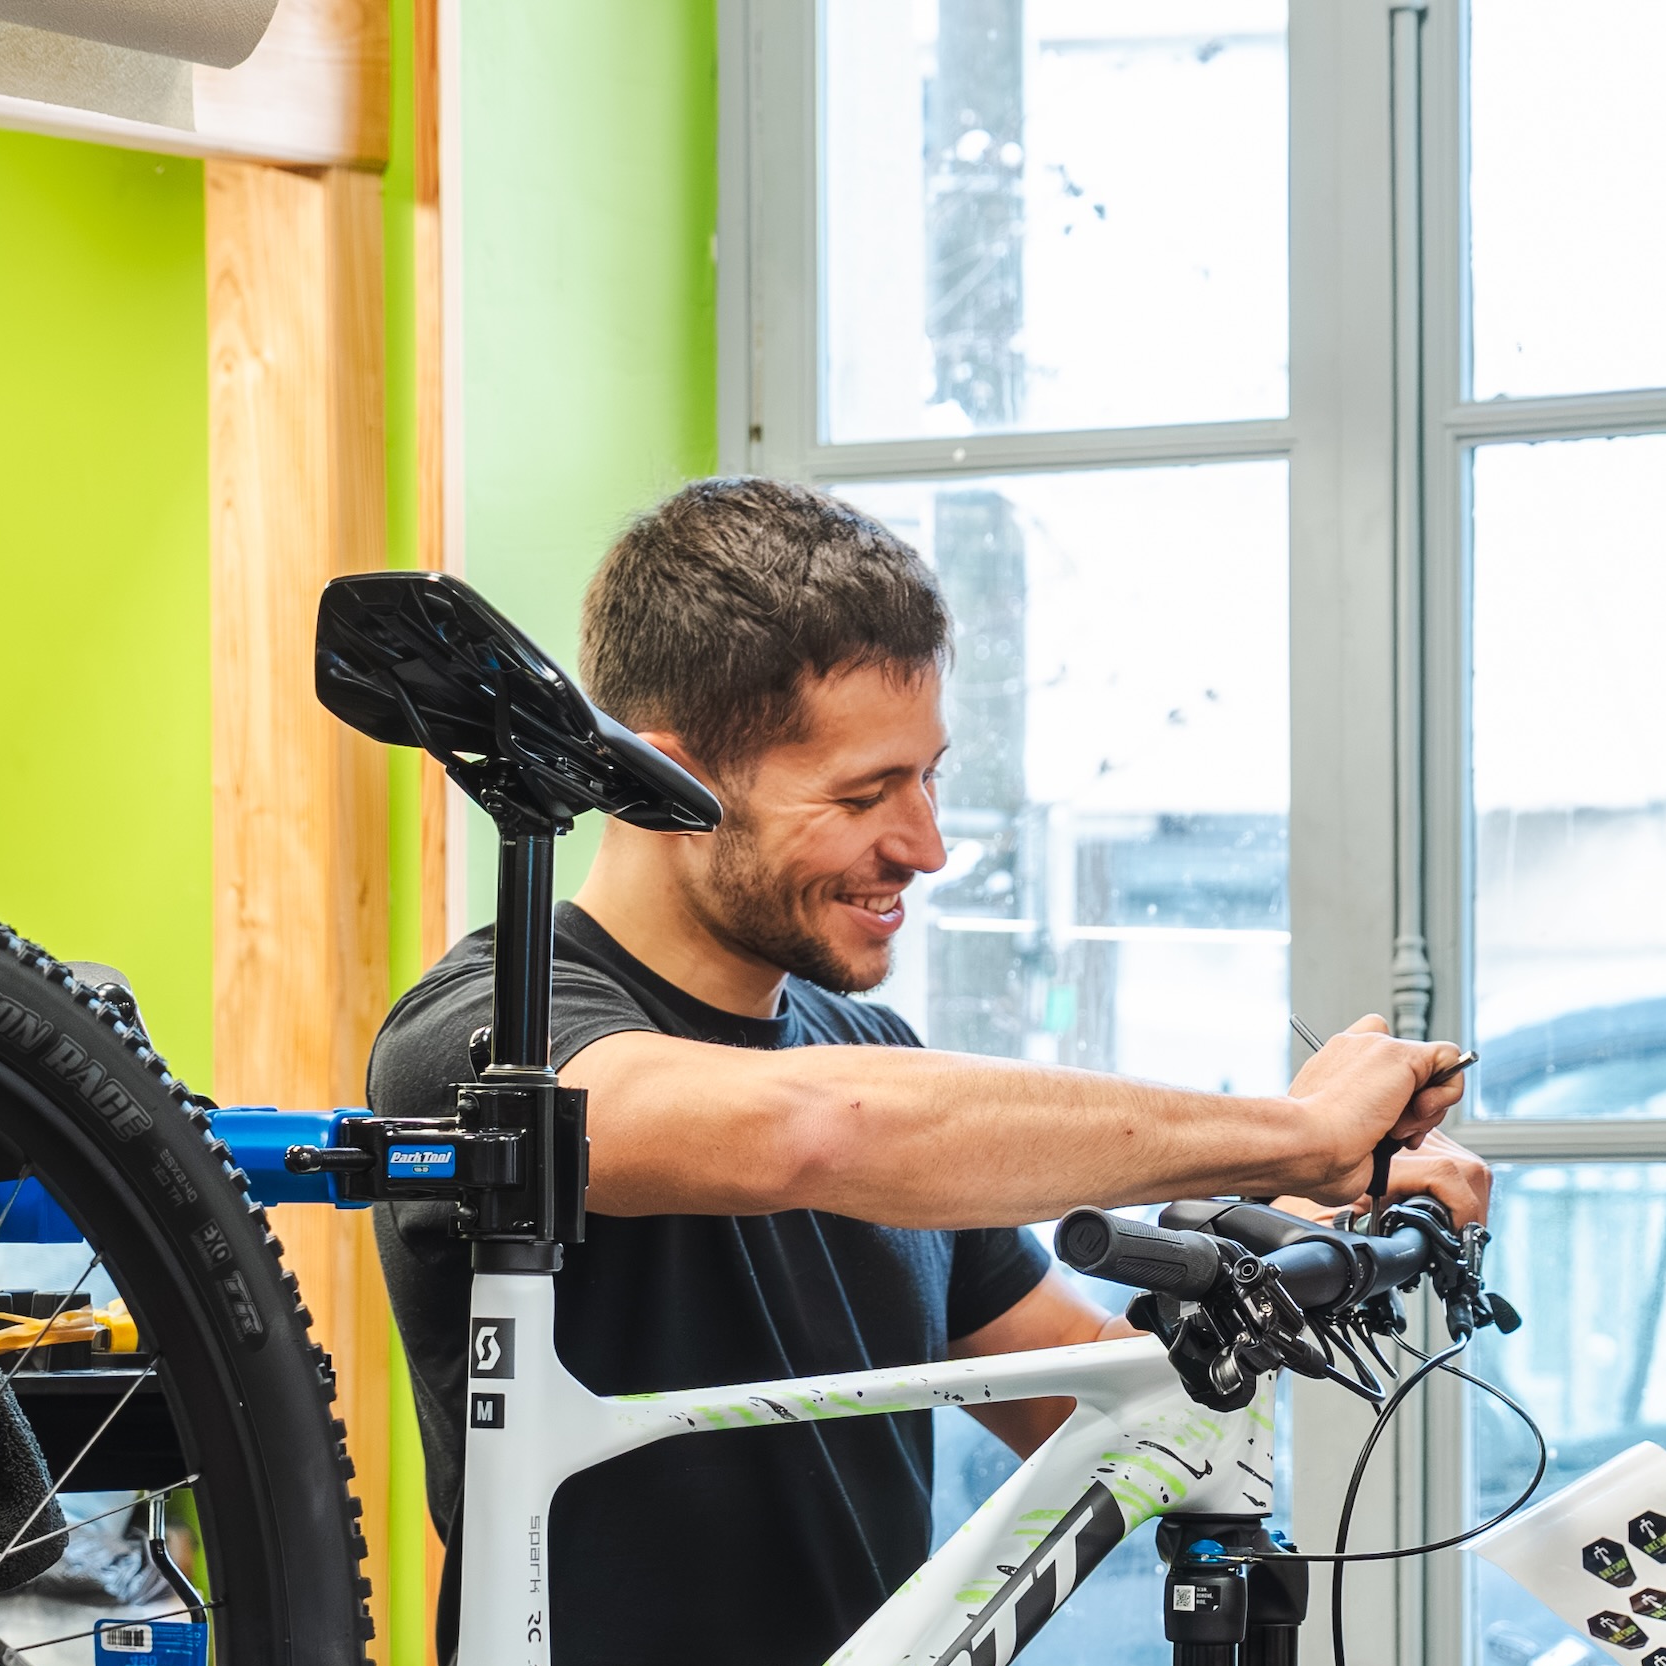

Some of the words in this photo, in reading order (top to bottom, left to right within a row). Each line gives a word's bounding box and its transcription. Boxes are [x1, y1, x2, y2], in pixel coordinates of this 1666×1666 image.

[38, 1033, 153, 1142] RACE
[203, 1223, 230, 1264] EXO
[476, 1400, 493, 1421] M
